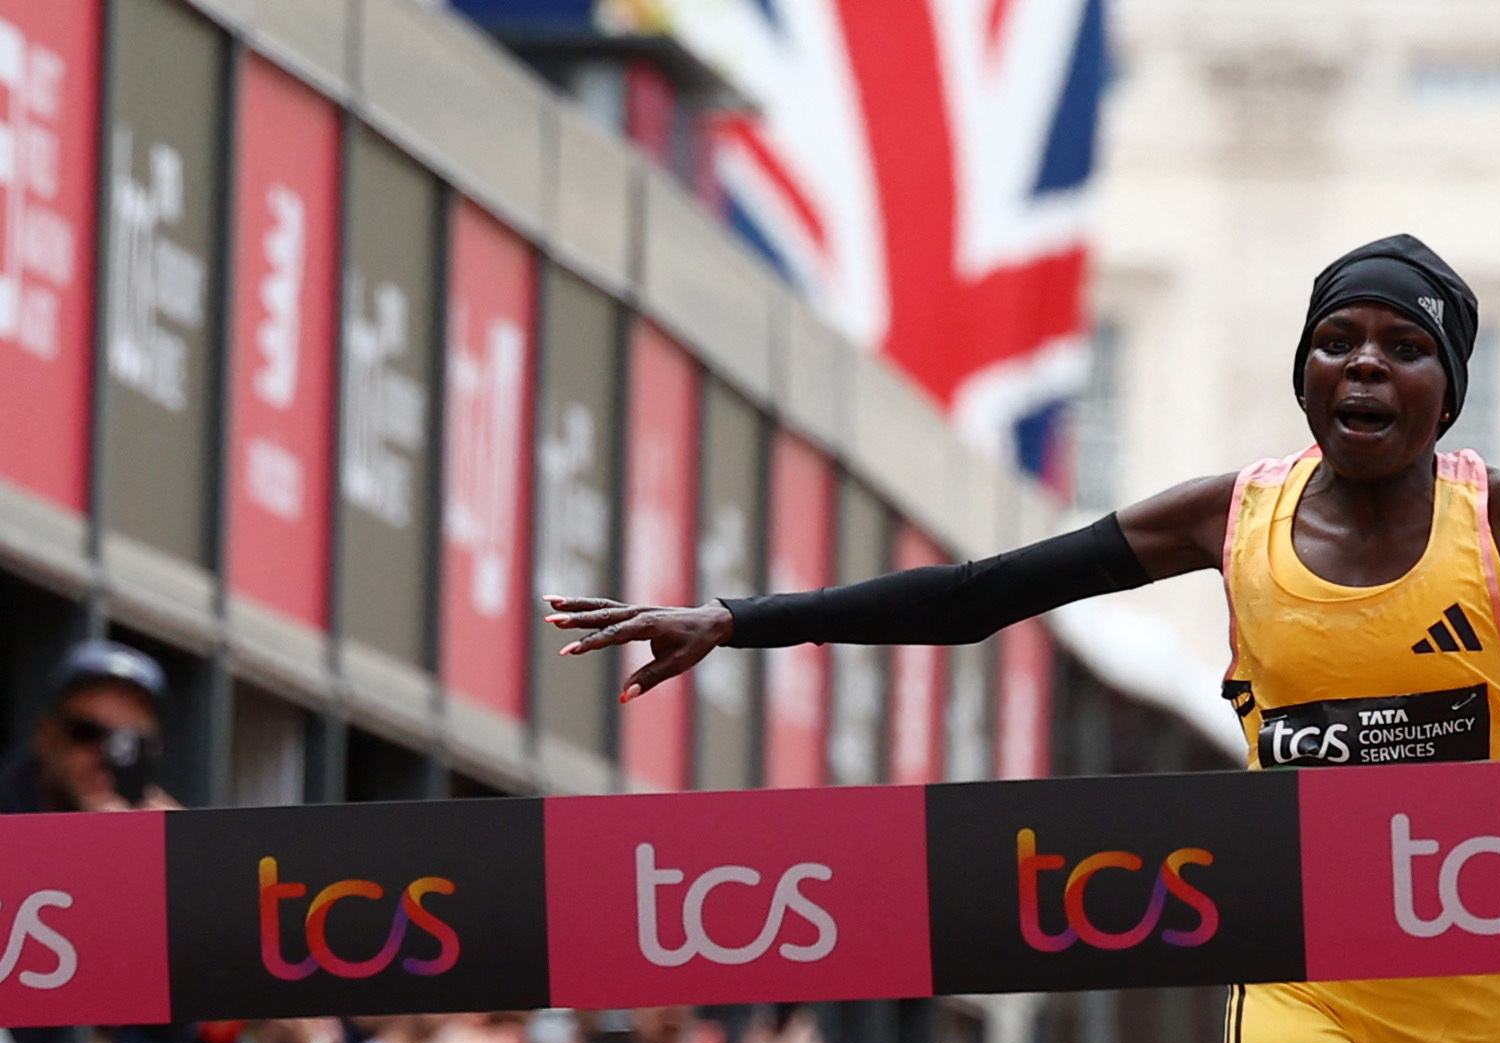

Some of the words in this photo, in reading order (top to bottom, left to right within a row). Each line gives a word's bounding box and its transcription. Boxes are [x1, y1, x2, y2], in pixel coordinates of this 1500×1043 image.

[1358, 710, 1409, 726] TATA
[1358, 717, 1476, 745] CONSULTANCY
[1273, 719, 1350, 764] tcs
[1360, 742, 1436, 763] SERVICES
[259, 856, 460, 981] tcs
[635, 842, 838, 967] tcs
[1017, 828, 1220, 952] tcs
